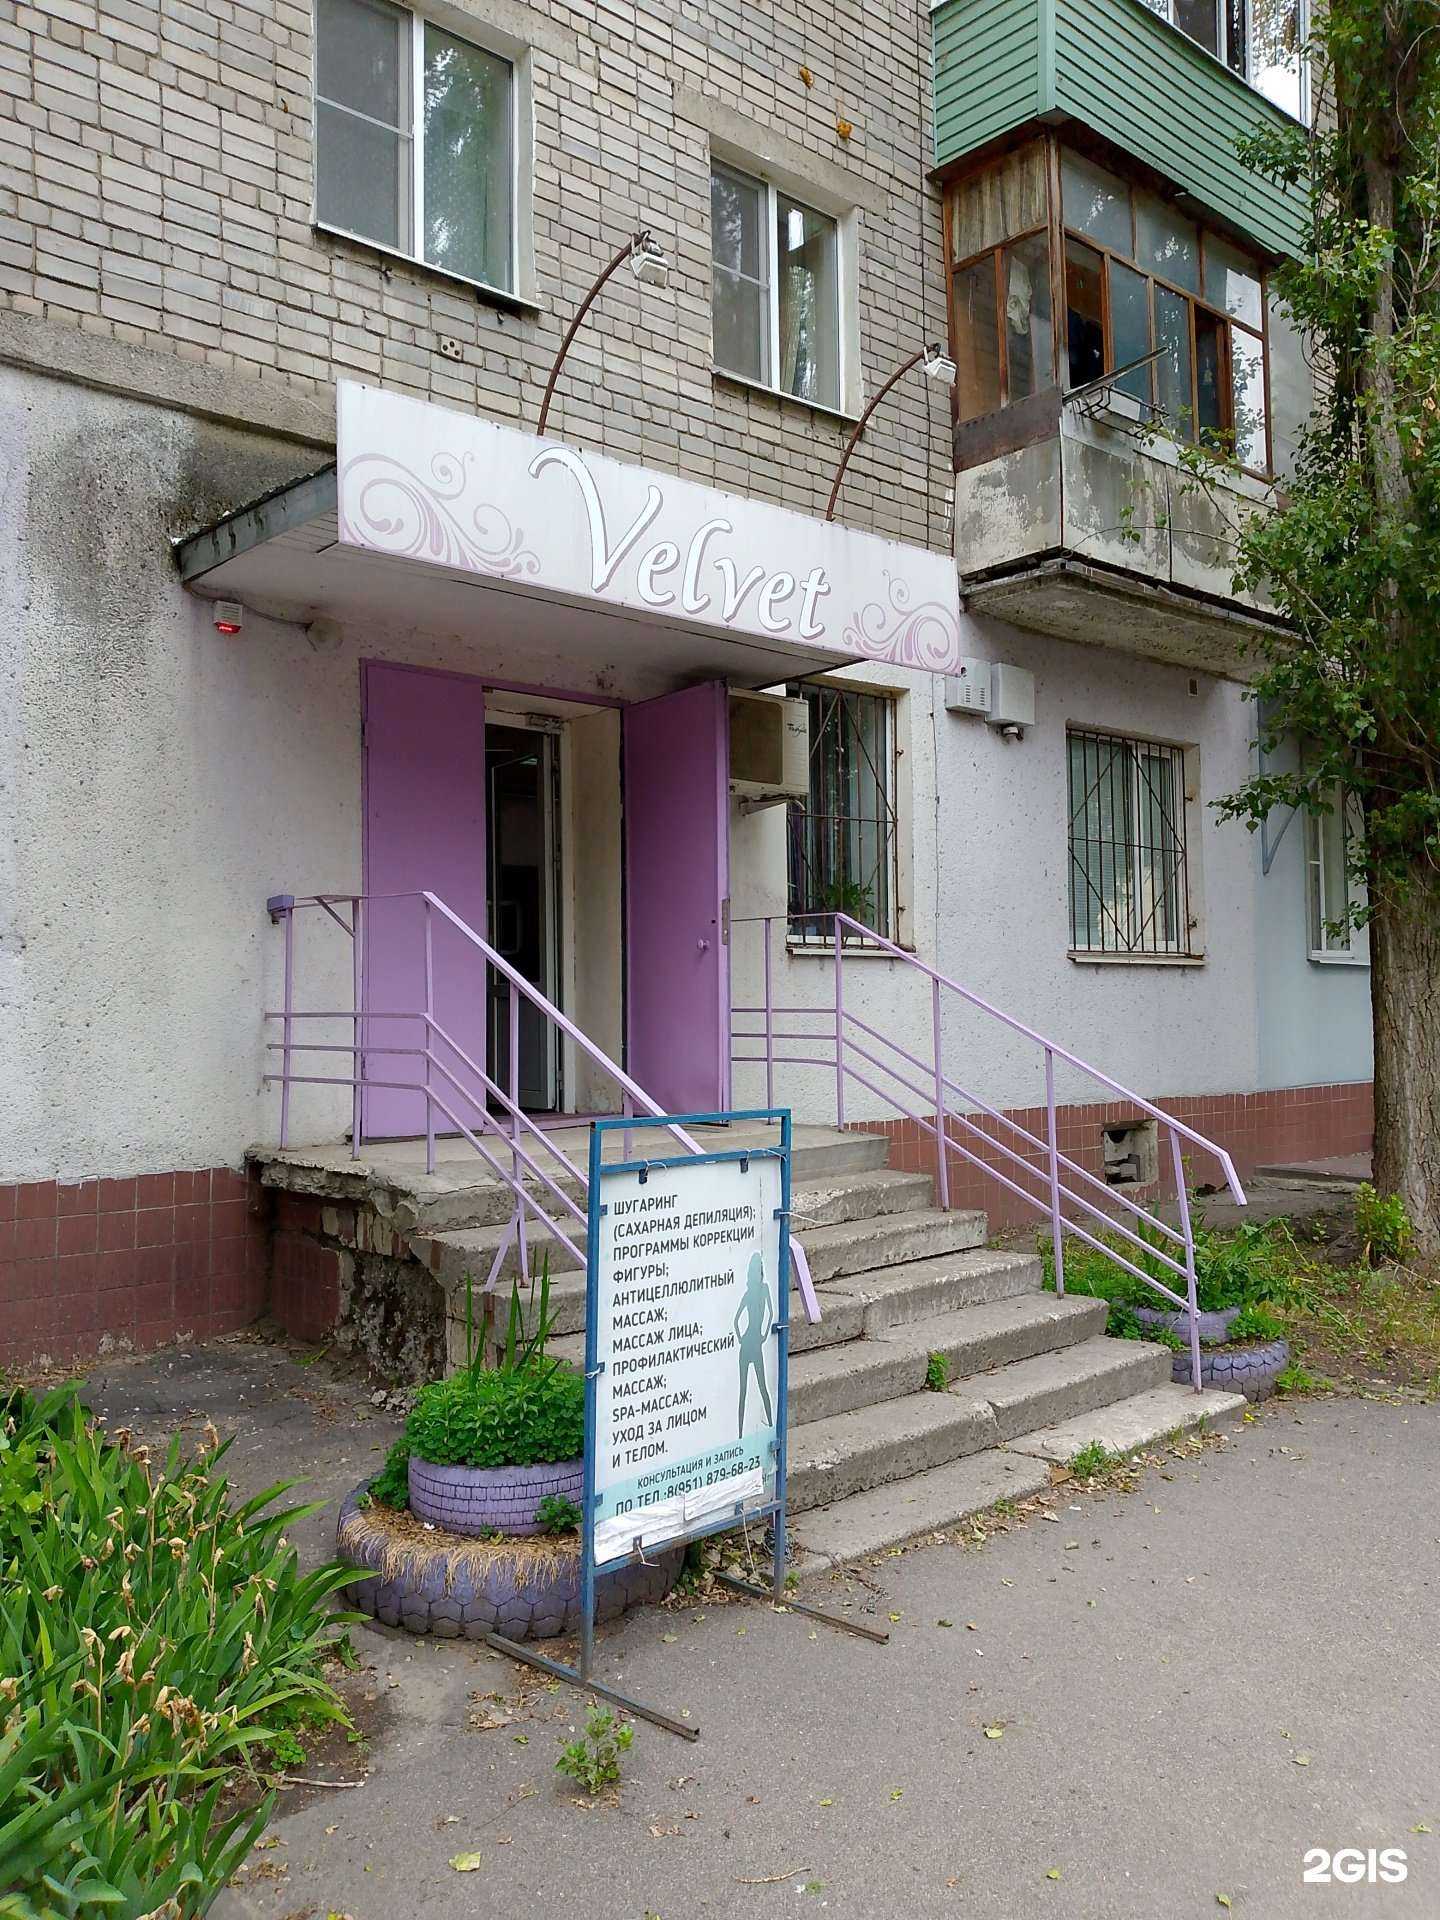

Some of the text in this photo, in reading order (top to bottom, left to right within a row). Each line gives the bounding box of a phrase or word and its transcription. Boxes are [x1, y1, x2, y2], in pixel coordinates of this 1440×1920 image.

[528, 446, 831, 640] Velvet
[614, 1194, 678, 1216] ШУГАРИНГ
[613, 1205, 756, 1242] (САХАРНАЯ ДЕПИЛЯЦИЯ);
[613, 1226, 754, 1261] ПРОГРАММЫ КОРРЕКЦИИ
[612, 1268, 734, 1308] АНТИЦЕЛЛЮЛИТНЫЙ
[613, 1262, 669, 1284] ФИГУРЫ;
[612, 1307, 668, 1331] МАССАЖ;
[612, 1321, 703, 1354] МАССАЖ ЛИЦА;
[612, 1333, 735, 1376] ПРОФИЛАКТИЧЕСКИЙ
[612, 1374, 667, 1399] МАССАЖ;
[612, 1389, 693, 1422] SPA-МАССАЖ;
[612, 1406, 707, 1446] УХОД ЗА ЛИЦОМ
[612, 1440, 669, 1469] И ТЕЛОМ.
[637, 1446, 744, 1489] КОНСУЛЬТАЦИЯ И ЗАПИСЬ
[616, 1499, 633, 1516] ПО
[706, 1455, 760, 1485] 879-68-23
